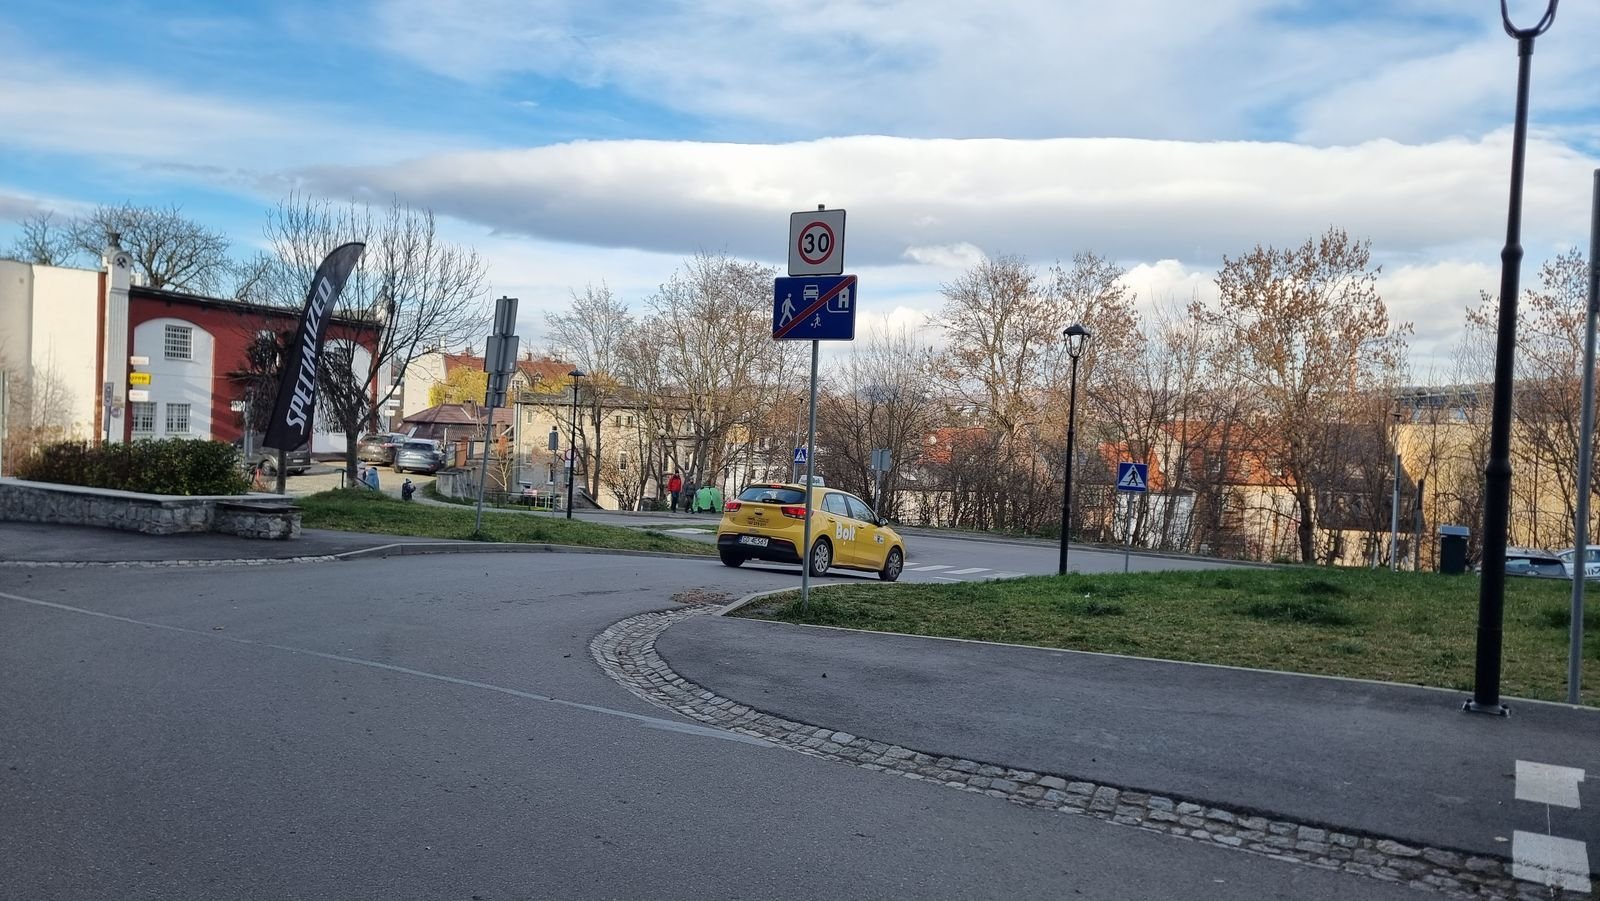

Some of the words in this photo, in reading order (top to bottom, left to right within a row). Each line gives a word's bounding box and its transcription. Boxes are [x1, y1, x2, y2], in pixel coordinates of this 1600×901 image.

[803, 232, 830, 254] 30
[286, 276, 332, 436] SPECIALIZED
[836, 521, 856, 542] Bolt
